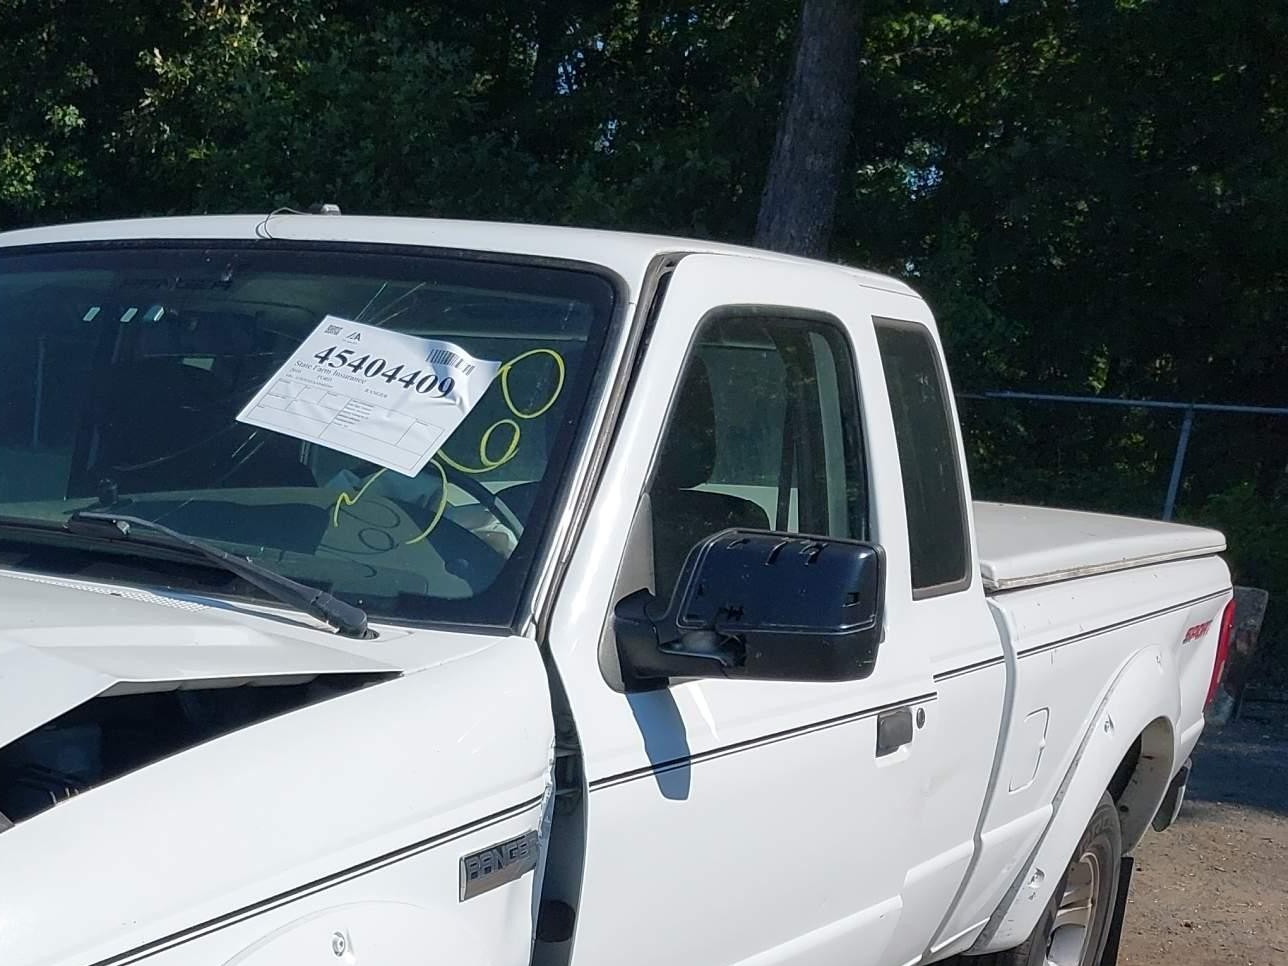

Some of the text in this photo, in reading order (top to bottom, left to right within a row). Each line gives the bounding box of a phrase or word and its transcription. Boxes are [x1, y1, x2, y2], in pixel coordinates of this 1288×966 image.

[294, 360, 313, 369] State
[313, 365, 332, 376] Farm
[332, 370, 367, 385] Insurance
[313, 345, 456, 399] 45404409
